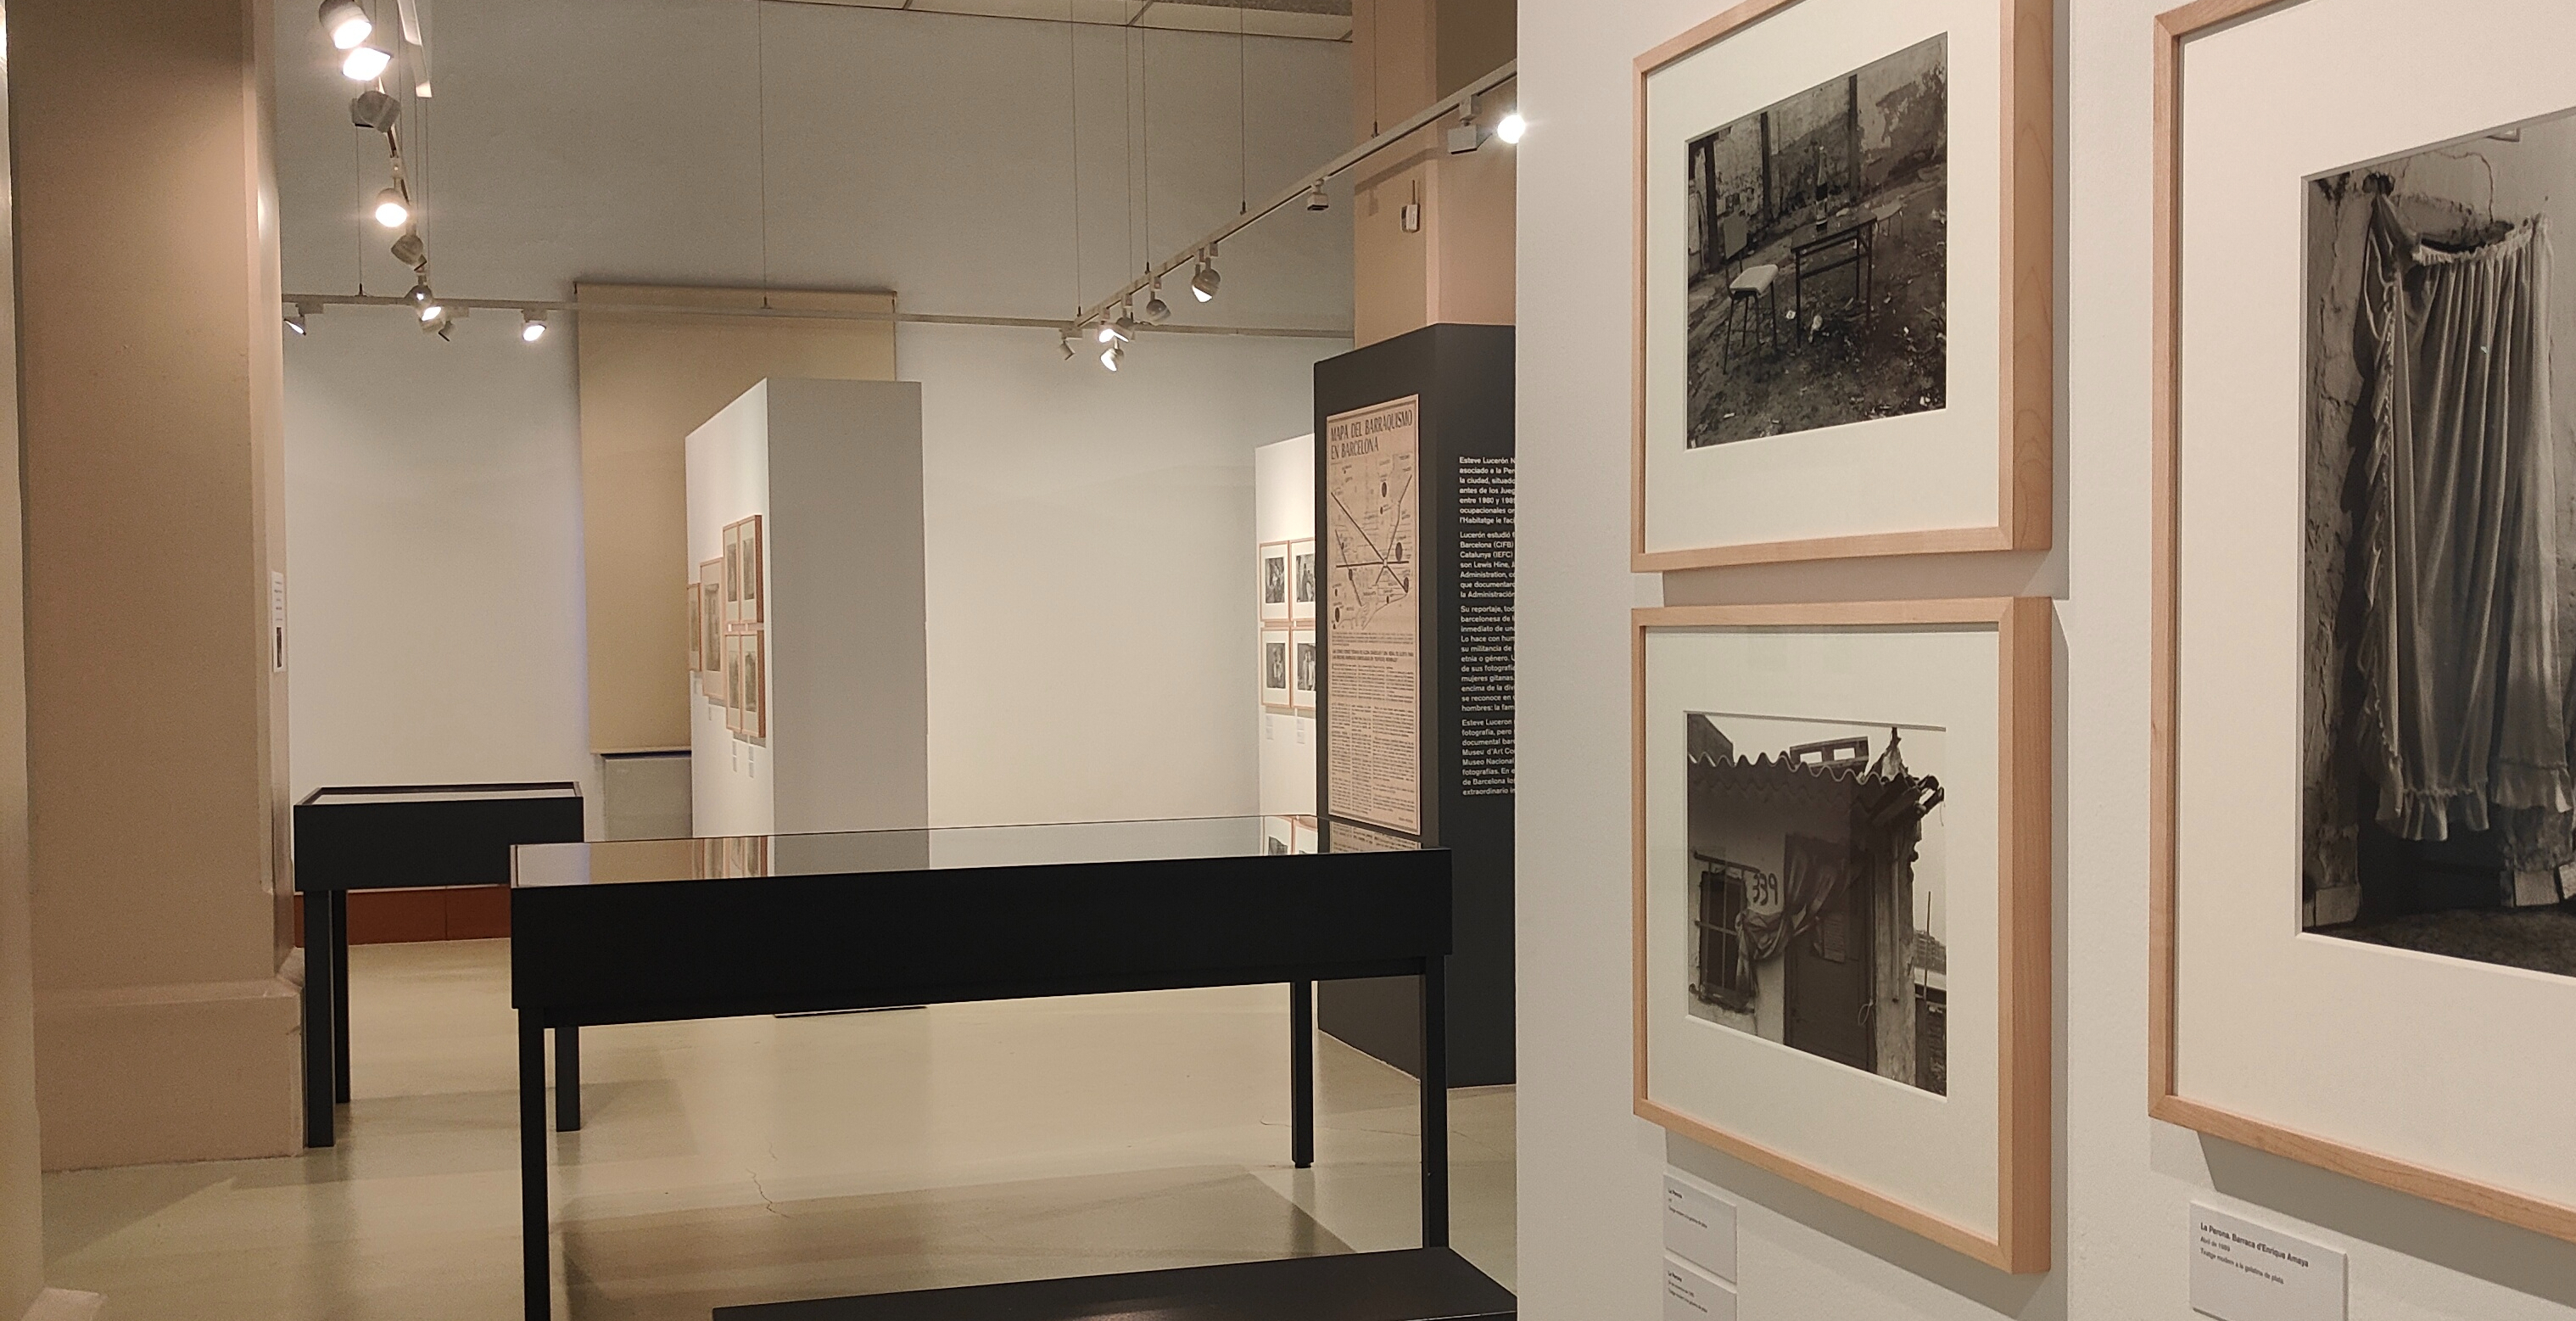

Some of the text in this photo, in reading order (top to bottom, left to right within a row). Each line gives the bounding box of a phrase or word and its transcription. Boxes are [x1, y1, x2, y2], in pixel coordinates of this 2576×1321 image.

[1331, 410, 1412, 441] MAPA DEL BARRAQUISMO
[1331, 436, 1378, 459] EN BARCELONA
[1752, 872, 1778, 906] 339
[2200, 1222, 2207, 1231] La
[2232, 1233, 2255, 1249] Barraca
[2287, 1252, 2309, 1268] Amaya
